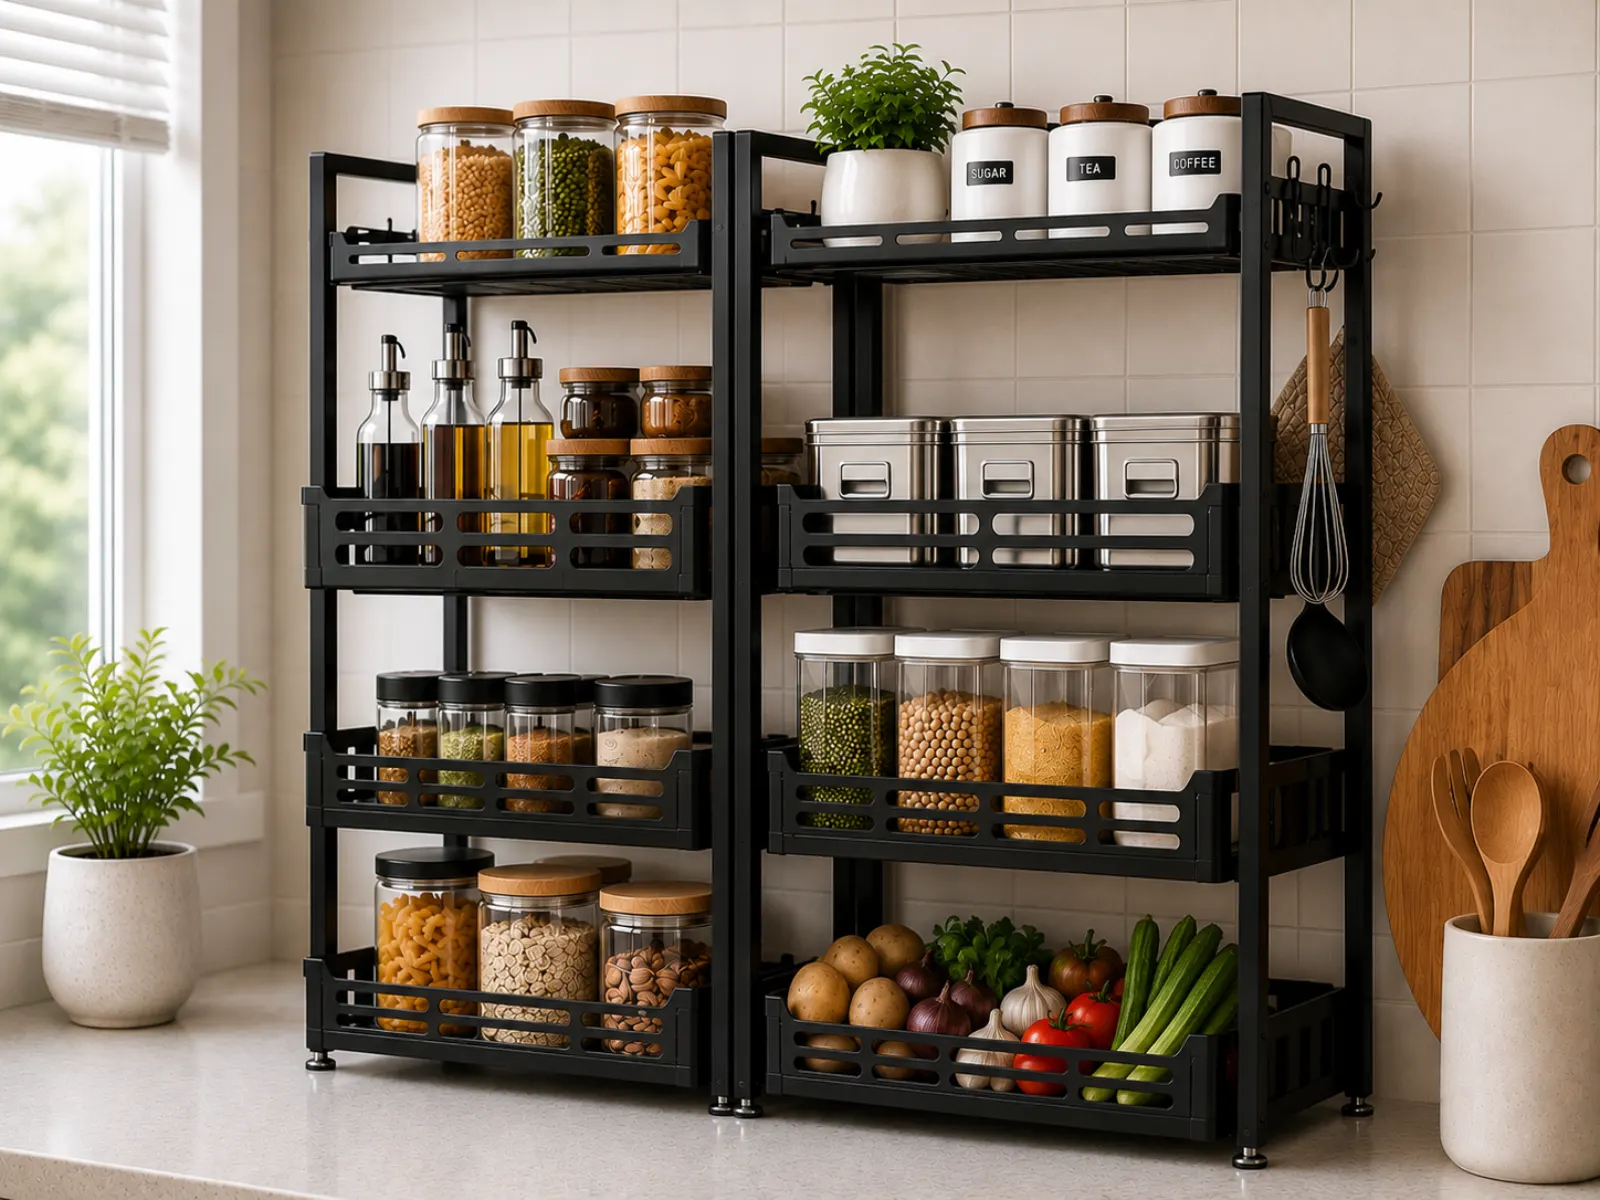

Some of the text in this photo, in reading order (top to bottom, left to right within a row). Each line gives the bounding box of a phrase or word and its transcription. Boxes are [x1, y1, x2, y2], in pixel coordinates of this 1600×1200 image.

[1079, 163, 1101, 174] TEA
[1173, 157, 1216, 170] COFFEE
[971, 167, 1006, 179] SUGAR
